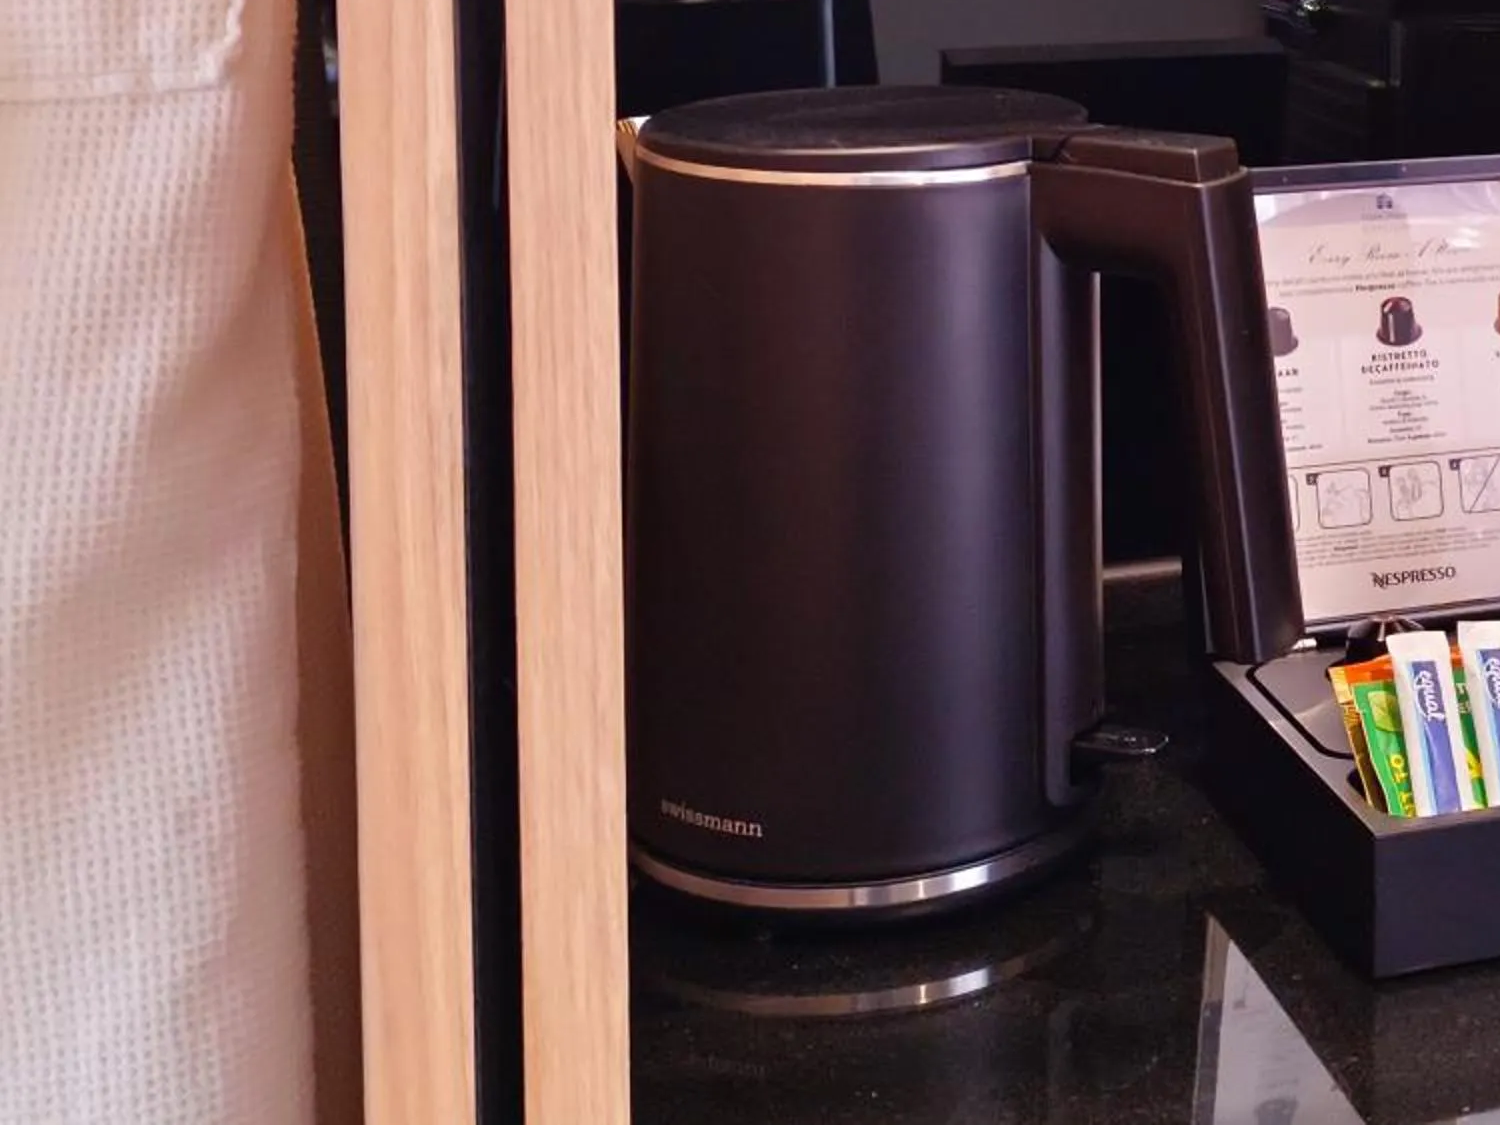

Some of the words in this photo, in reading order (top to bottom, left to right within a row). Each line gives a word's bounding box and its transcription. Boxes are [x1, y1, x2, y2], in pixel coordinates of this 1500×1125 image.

[1371, 349, 1427, 362] RISTRETTO
[1371, 565, 1457, 590] NESPRESSO
[1414, 670, 1446, 723] equal
[661, 798, 763, 838] swissmann
